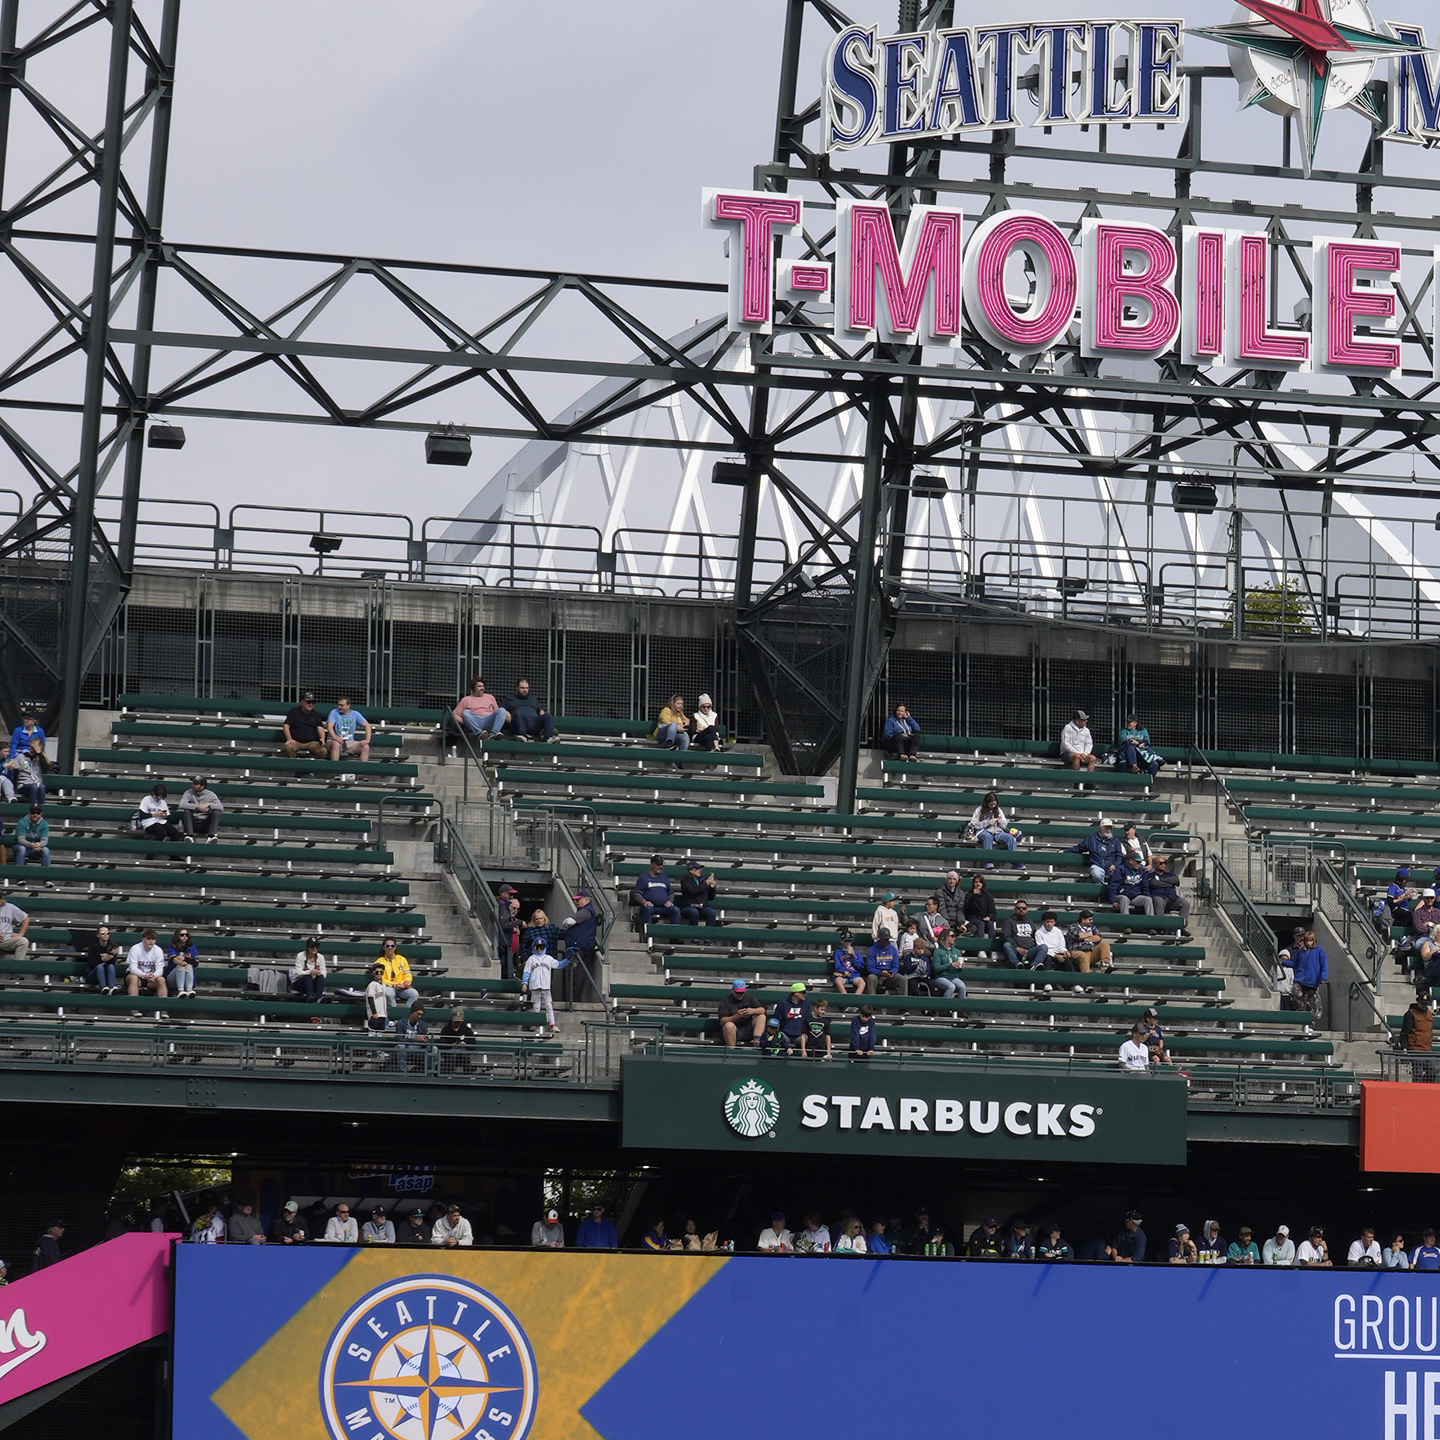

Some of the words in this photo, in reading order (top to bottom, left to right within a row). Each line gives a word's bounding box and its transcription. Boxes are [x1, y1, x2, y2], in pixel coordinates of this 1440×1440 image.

[824, 18, 1185, 153] SEATTLE
[703, 187, 1403, 378] T-MOBILE
[800, 1094, 1097, 1138] STARBUCKS
[347, 1296, 511, 1363] SEATTLE
